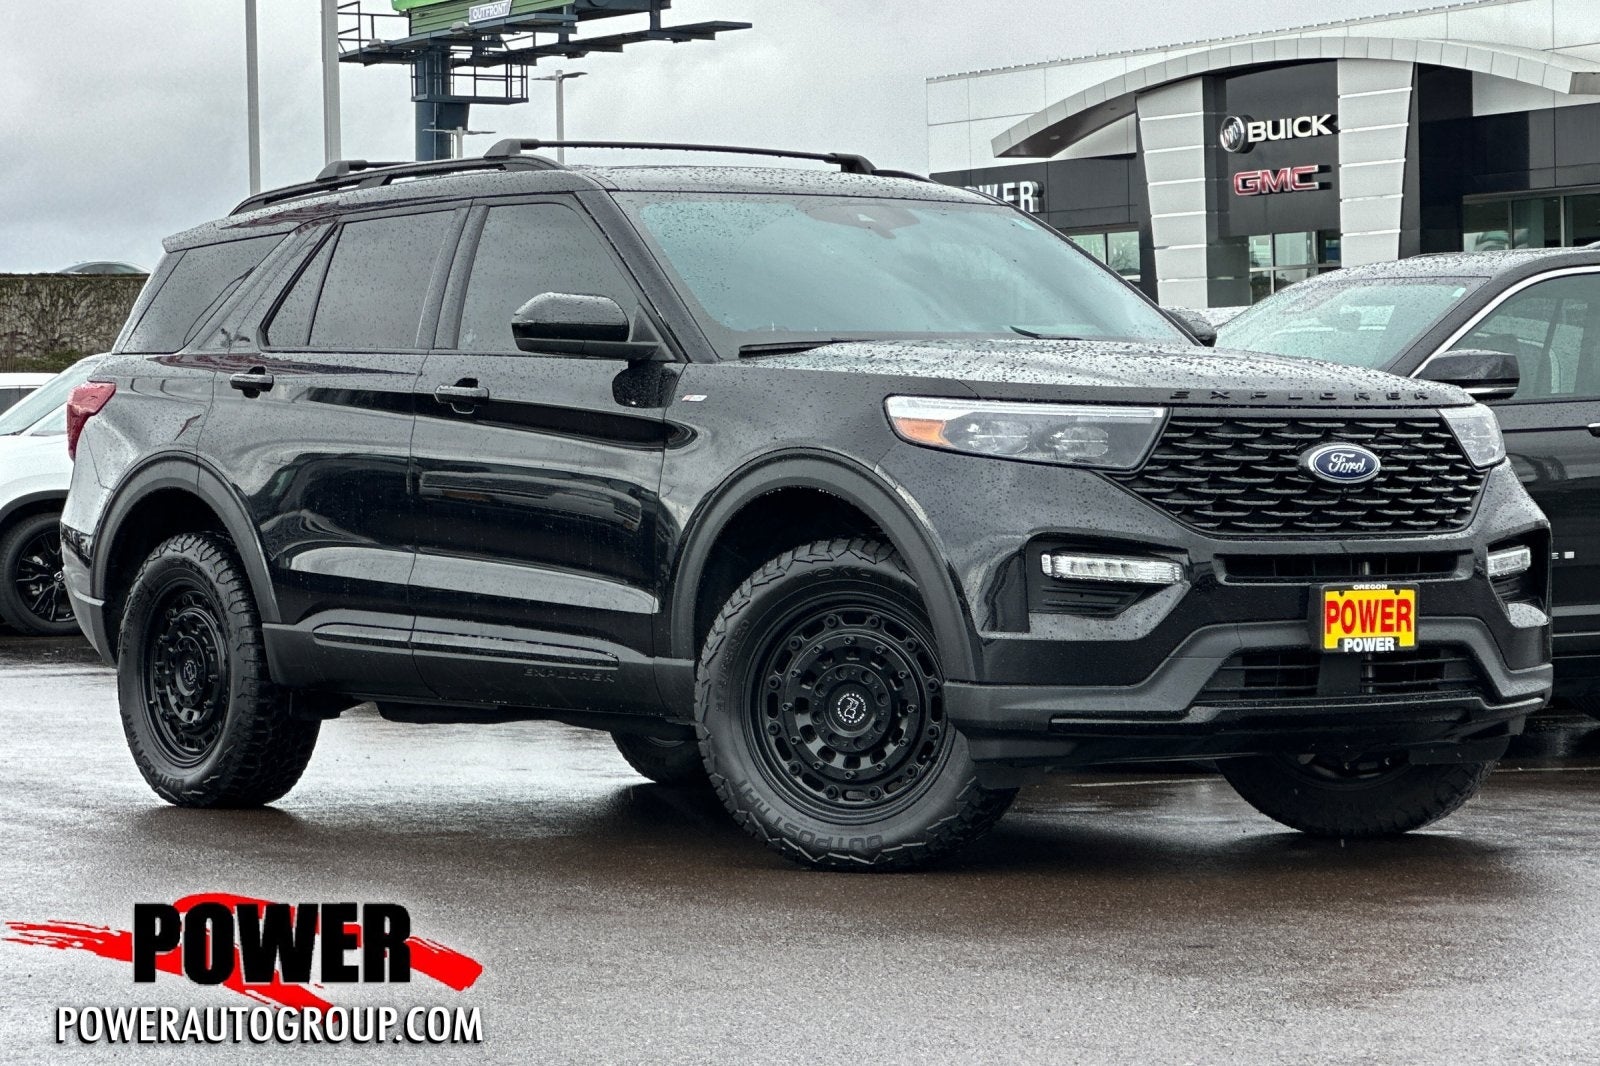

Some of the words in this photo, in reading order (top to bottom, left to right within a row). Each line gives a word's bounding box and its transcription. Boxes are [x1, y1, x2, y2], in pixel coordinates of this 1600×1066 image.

[472, 3, 507, 19] OUTFRONT
[1248, 114, 1332, 142] BUICK
[1233, 164, 1319, 196] GMC
[1169, 390, 1430, 401] EXPLORER
[1328, 452, 1366, 473] Ford
[1326, 598, 1412, 634] POWER
[1344, 637, 1395, 652] POWER
